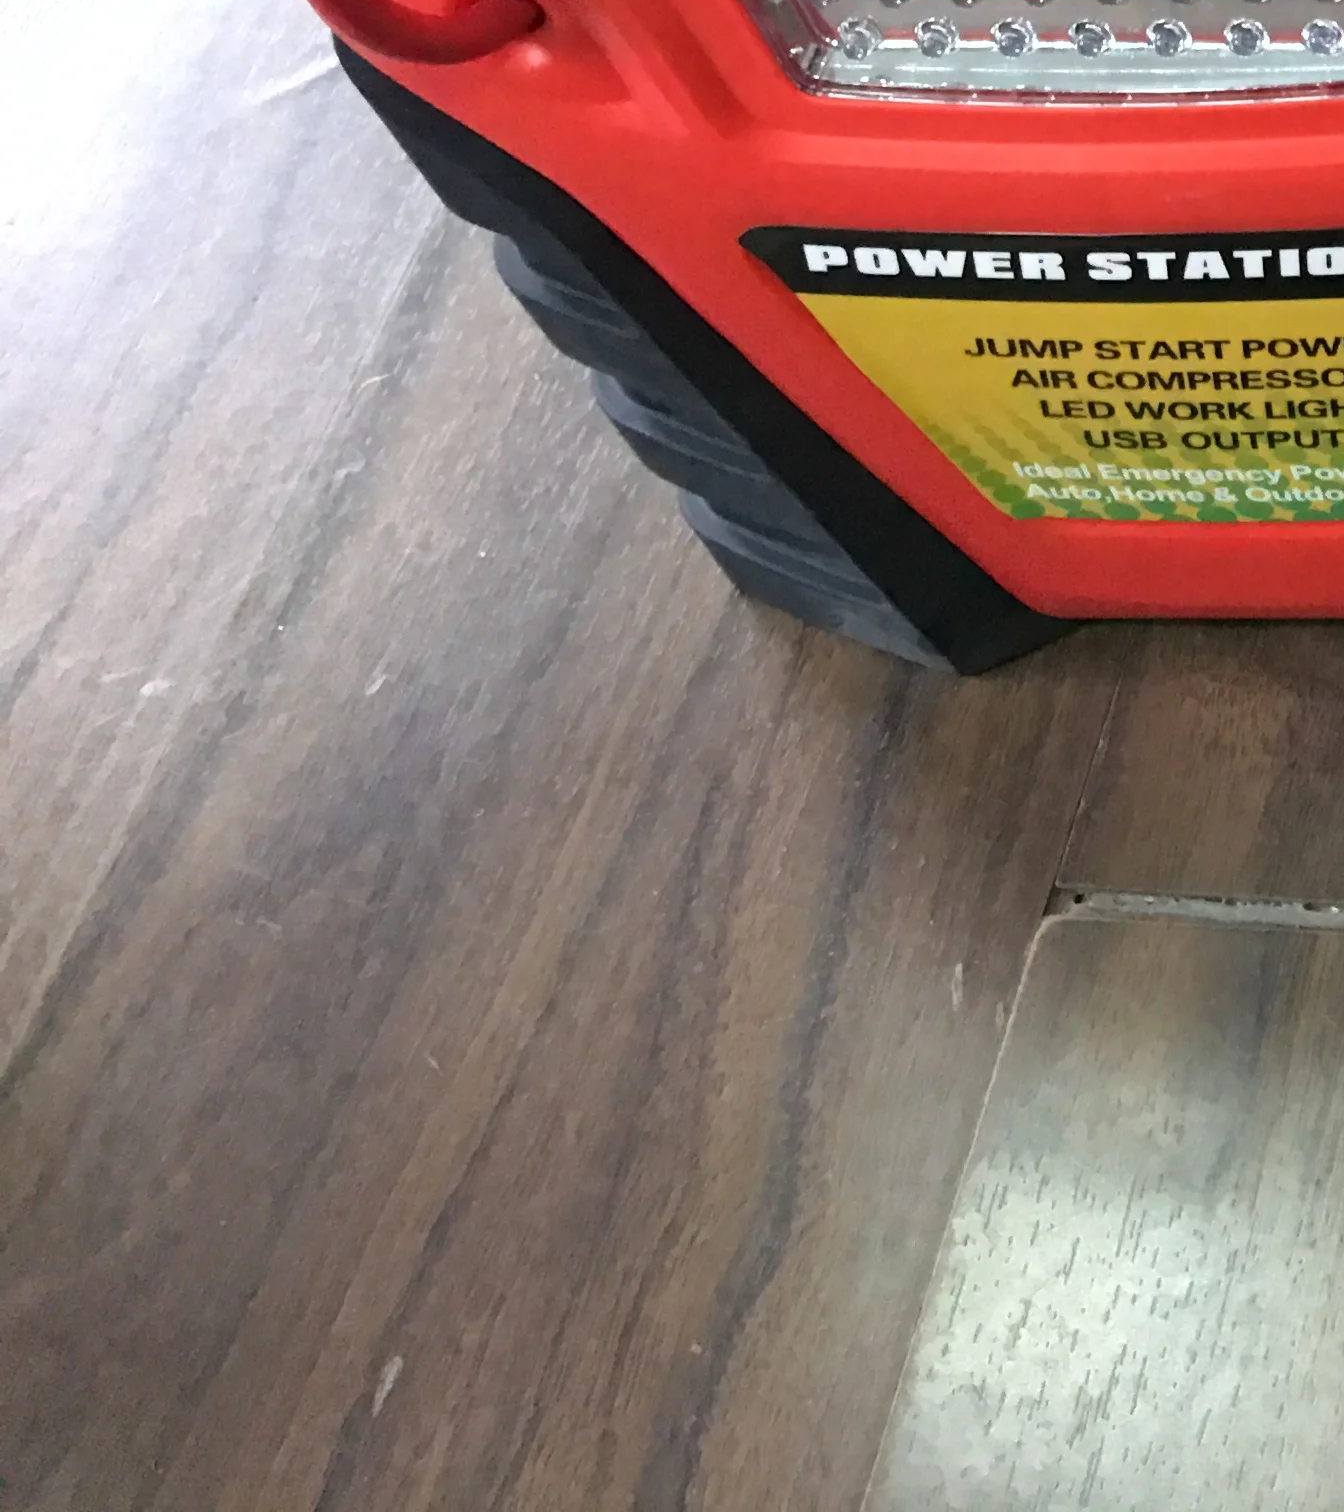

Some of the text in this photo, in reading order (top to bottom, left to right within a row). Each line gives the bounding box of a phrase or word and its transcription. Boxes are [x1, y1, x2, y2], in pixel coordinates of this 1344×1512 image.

[802, 243, 1066, 281] POWER
[964, 337, 1084, 360] JUMP
[1094, 339, 1231, 361] START
[1011, 369, 1078, 389] AIR
[1039, 399, 1116, 420] LED
[1124, 400, 1255, 421] WORK
[1083, 429, 1168, 450] USB
[1012, 461, 1092, 480] Ideal
[1096, 463, 1282, 486] Emergency
[1213, 486, 1239, 503] &
